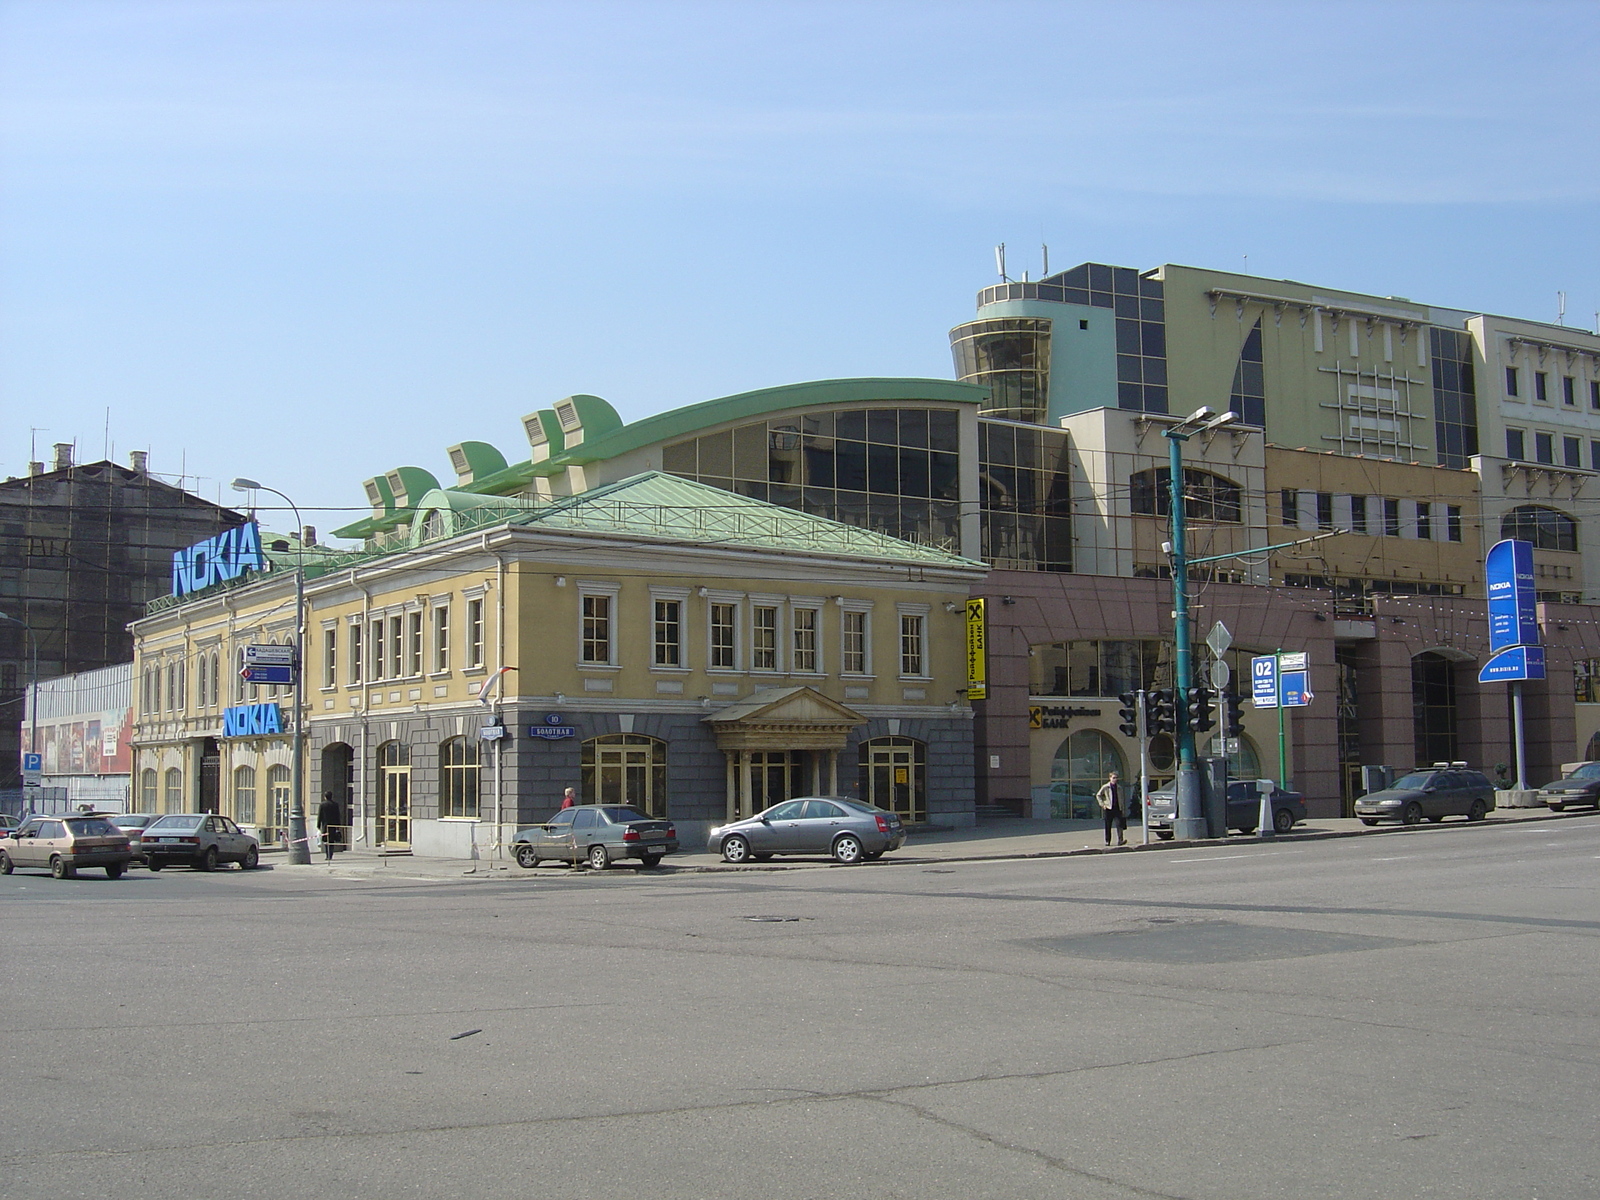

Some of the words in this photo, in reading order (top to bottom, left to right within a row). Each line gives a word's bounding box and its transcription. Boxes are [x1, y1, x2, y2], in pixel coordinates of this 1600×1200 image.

[173, 521, 260, 598] NOKIA
[1489, 581, 1511, 591] NOKIA
[1255, 661, 1272, 677] 02
[223, 702, 281, 737] NOKIA
[1042, 718, 1069, 729] БАНК
